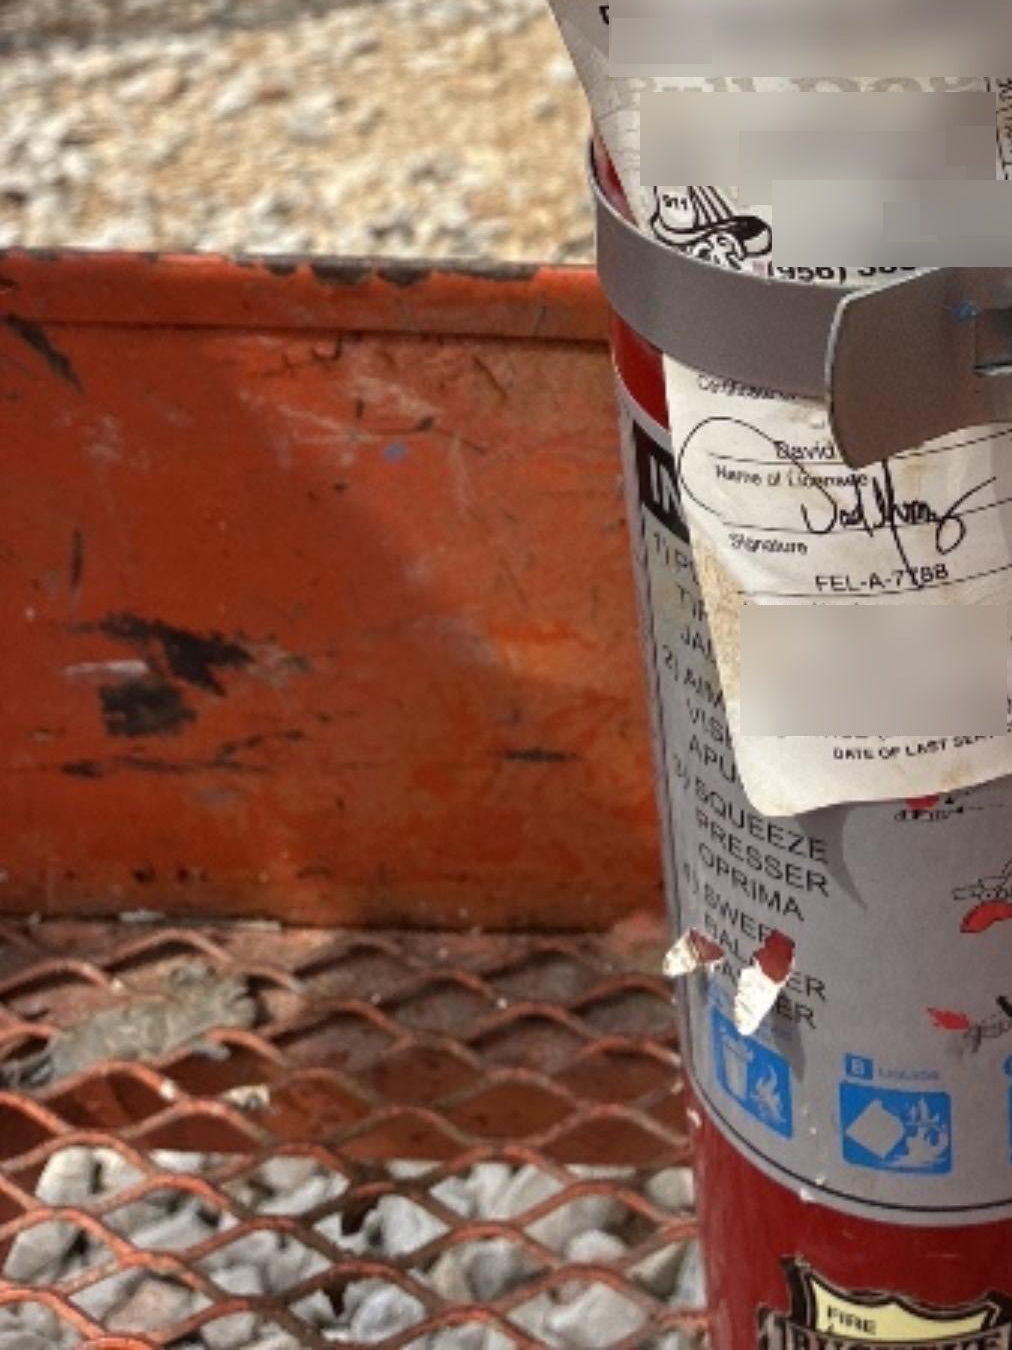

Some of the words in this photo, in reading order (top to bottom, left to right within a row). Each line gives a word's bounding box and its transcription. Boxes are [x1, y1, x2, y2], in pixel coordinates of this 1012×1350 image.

[695, 777, 829, 866] SQUEEZE
[695, 809, 830, 898] PRESSER
[698, 841, 805, 923] OPRIMA
[827, 1306, 877, 1335] FIRE
